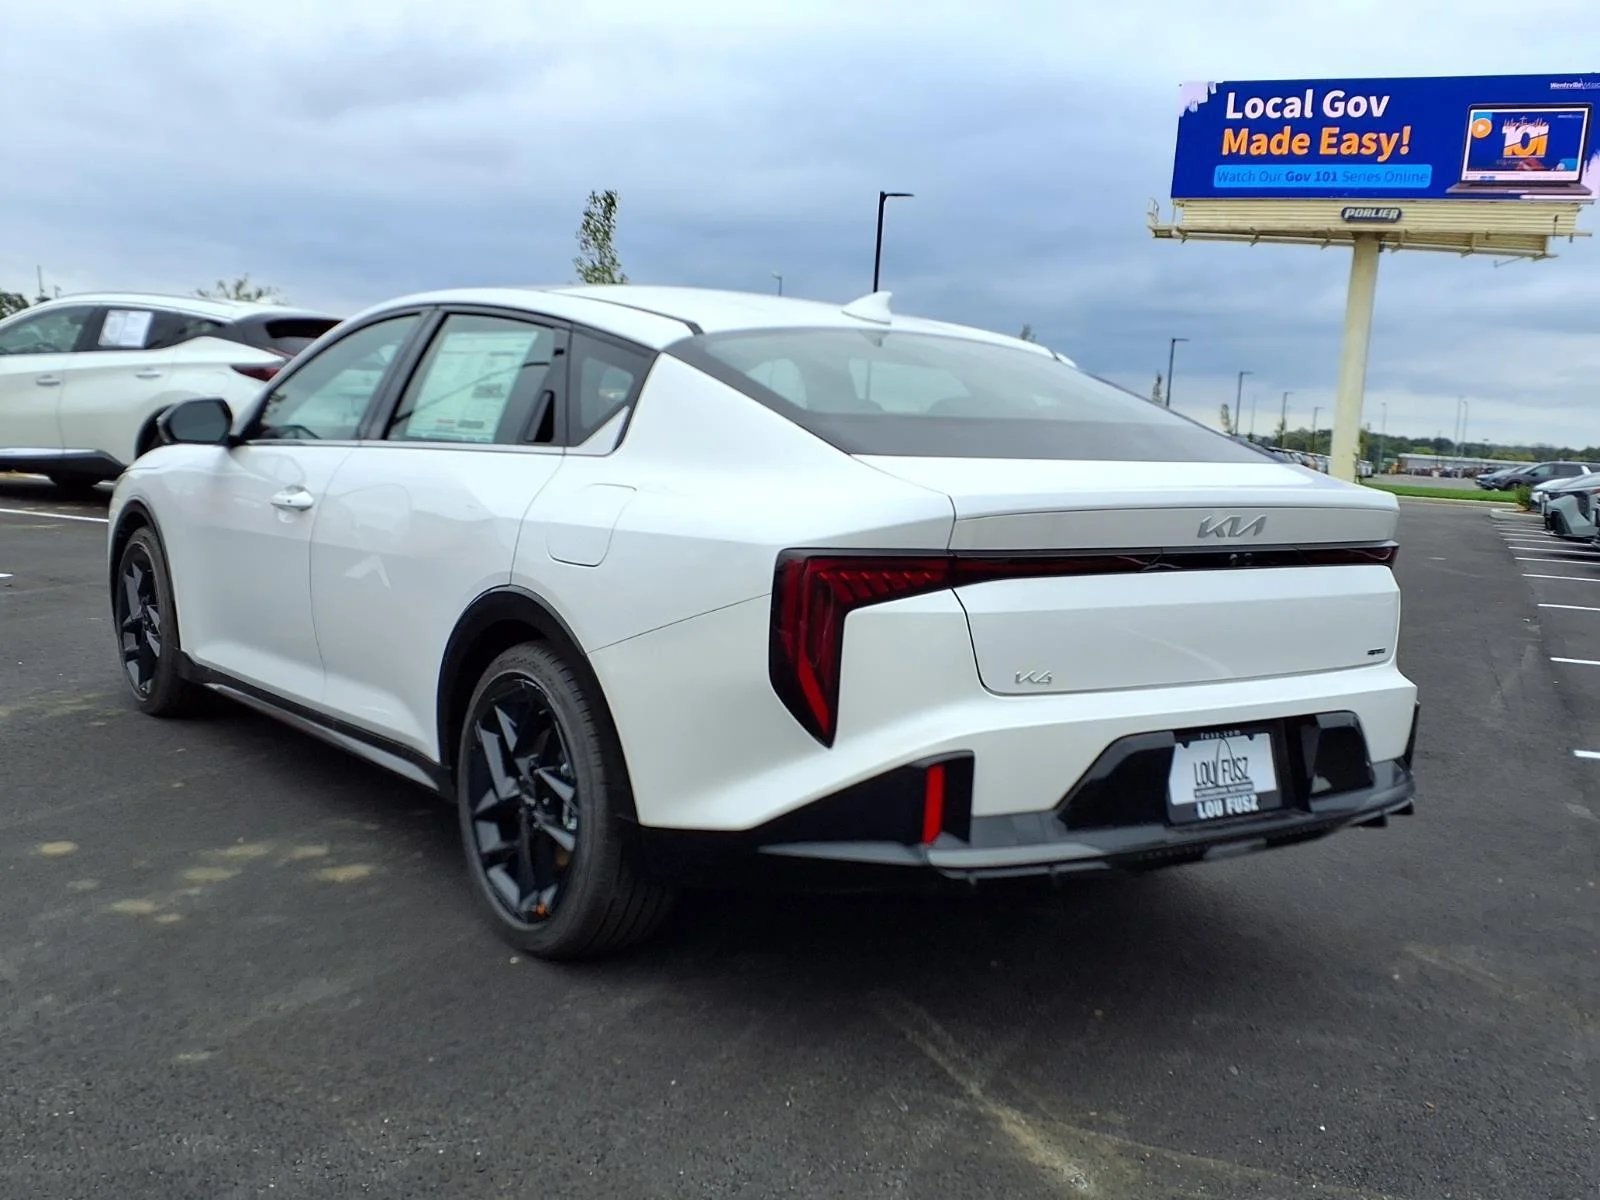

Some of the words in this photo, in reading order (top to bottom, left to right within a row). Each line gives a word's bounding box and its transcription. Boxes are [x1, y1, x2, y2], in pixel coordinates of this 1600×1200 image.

[1225, 88, 1314, 120] Local
[1322, 89, 1390, 119] Gov
[1221, 125, 1311, 156] Made
[1319, 125, 1412, 163] Easy!
[1502, 124, 1549, 158] 101
[1216, 170, 1256, 184] Watch
[1258, 170, 1282, 183] Our
[1285, 170, 1311, 183] Gov
[1314, 170, 1338, 182] 101
[1342, 170, 1382, 183] Series
[1385, 169, 1428, 183] Online
[1343, 207, 1400, 220] PORLIER
[1197, 514, 1267, 538] KIA
[1194, 760, 1217, 787] LOU
[1197, 799, 1224, 819] LOU
[1225, 794, 1260, 815] FUSZ
